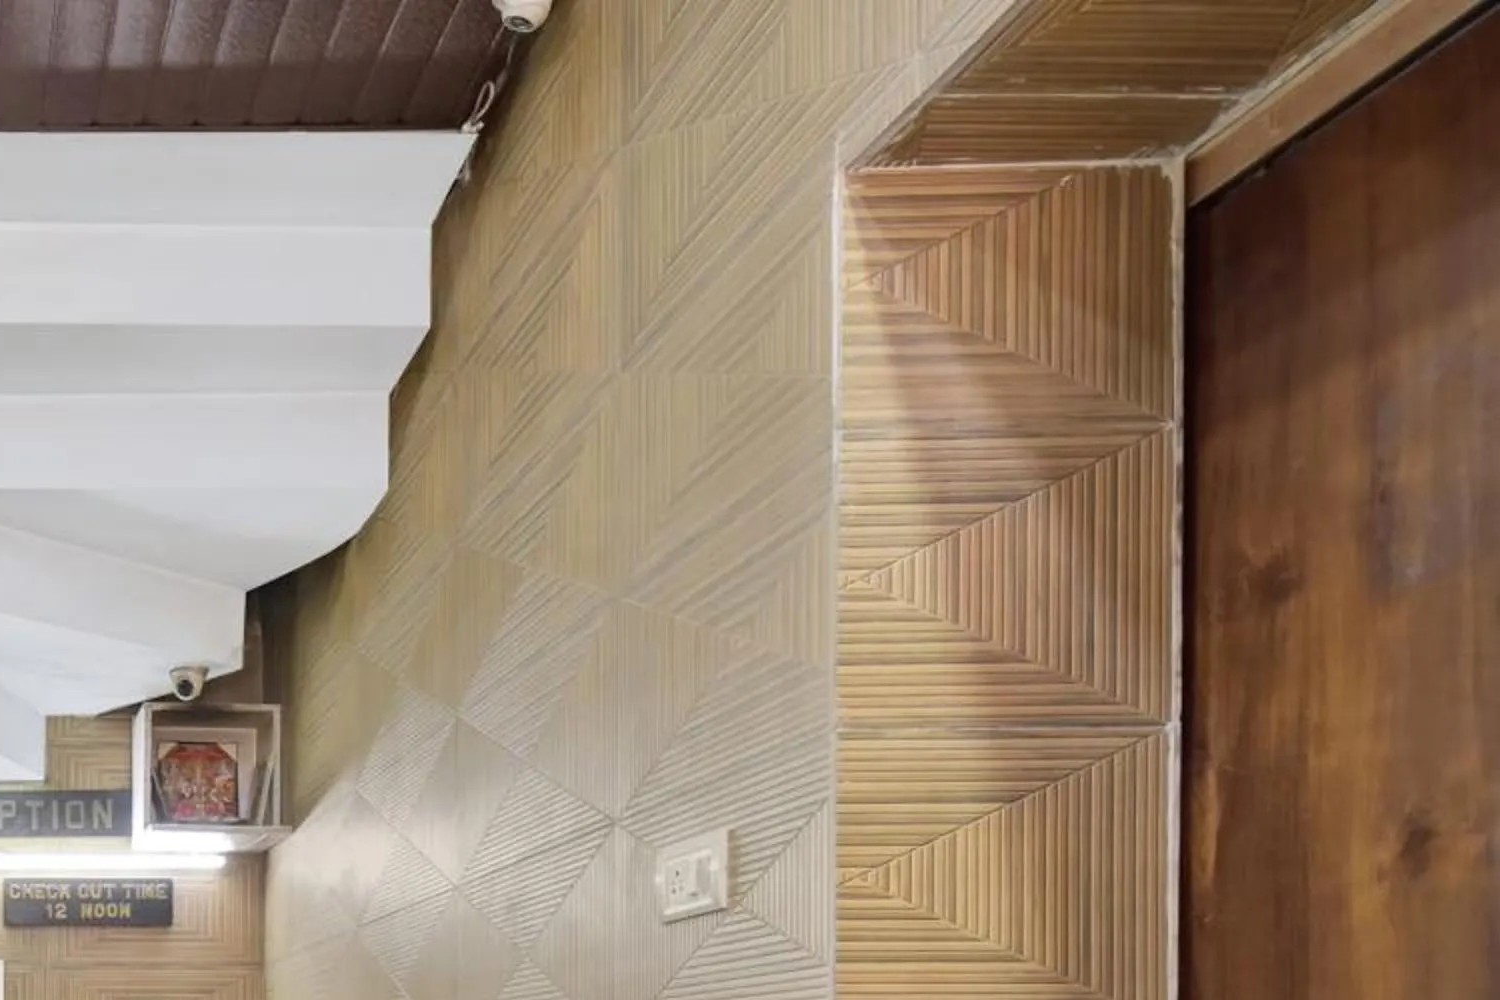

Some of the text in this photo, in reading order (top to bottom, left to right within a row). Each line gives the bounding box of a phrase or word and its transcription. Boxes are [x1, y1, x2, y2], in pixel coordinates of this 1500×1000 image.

[8, 882, 169, 900] CHECK OUT TIME
[45, 902, 132, 919] 12 NOON
